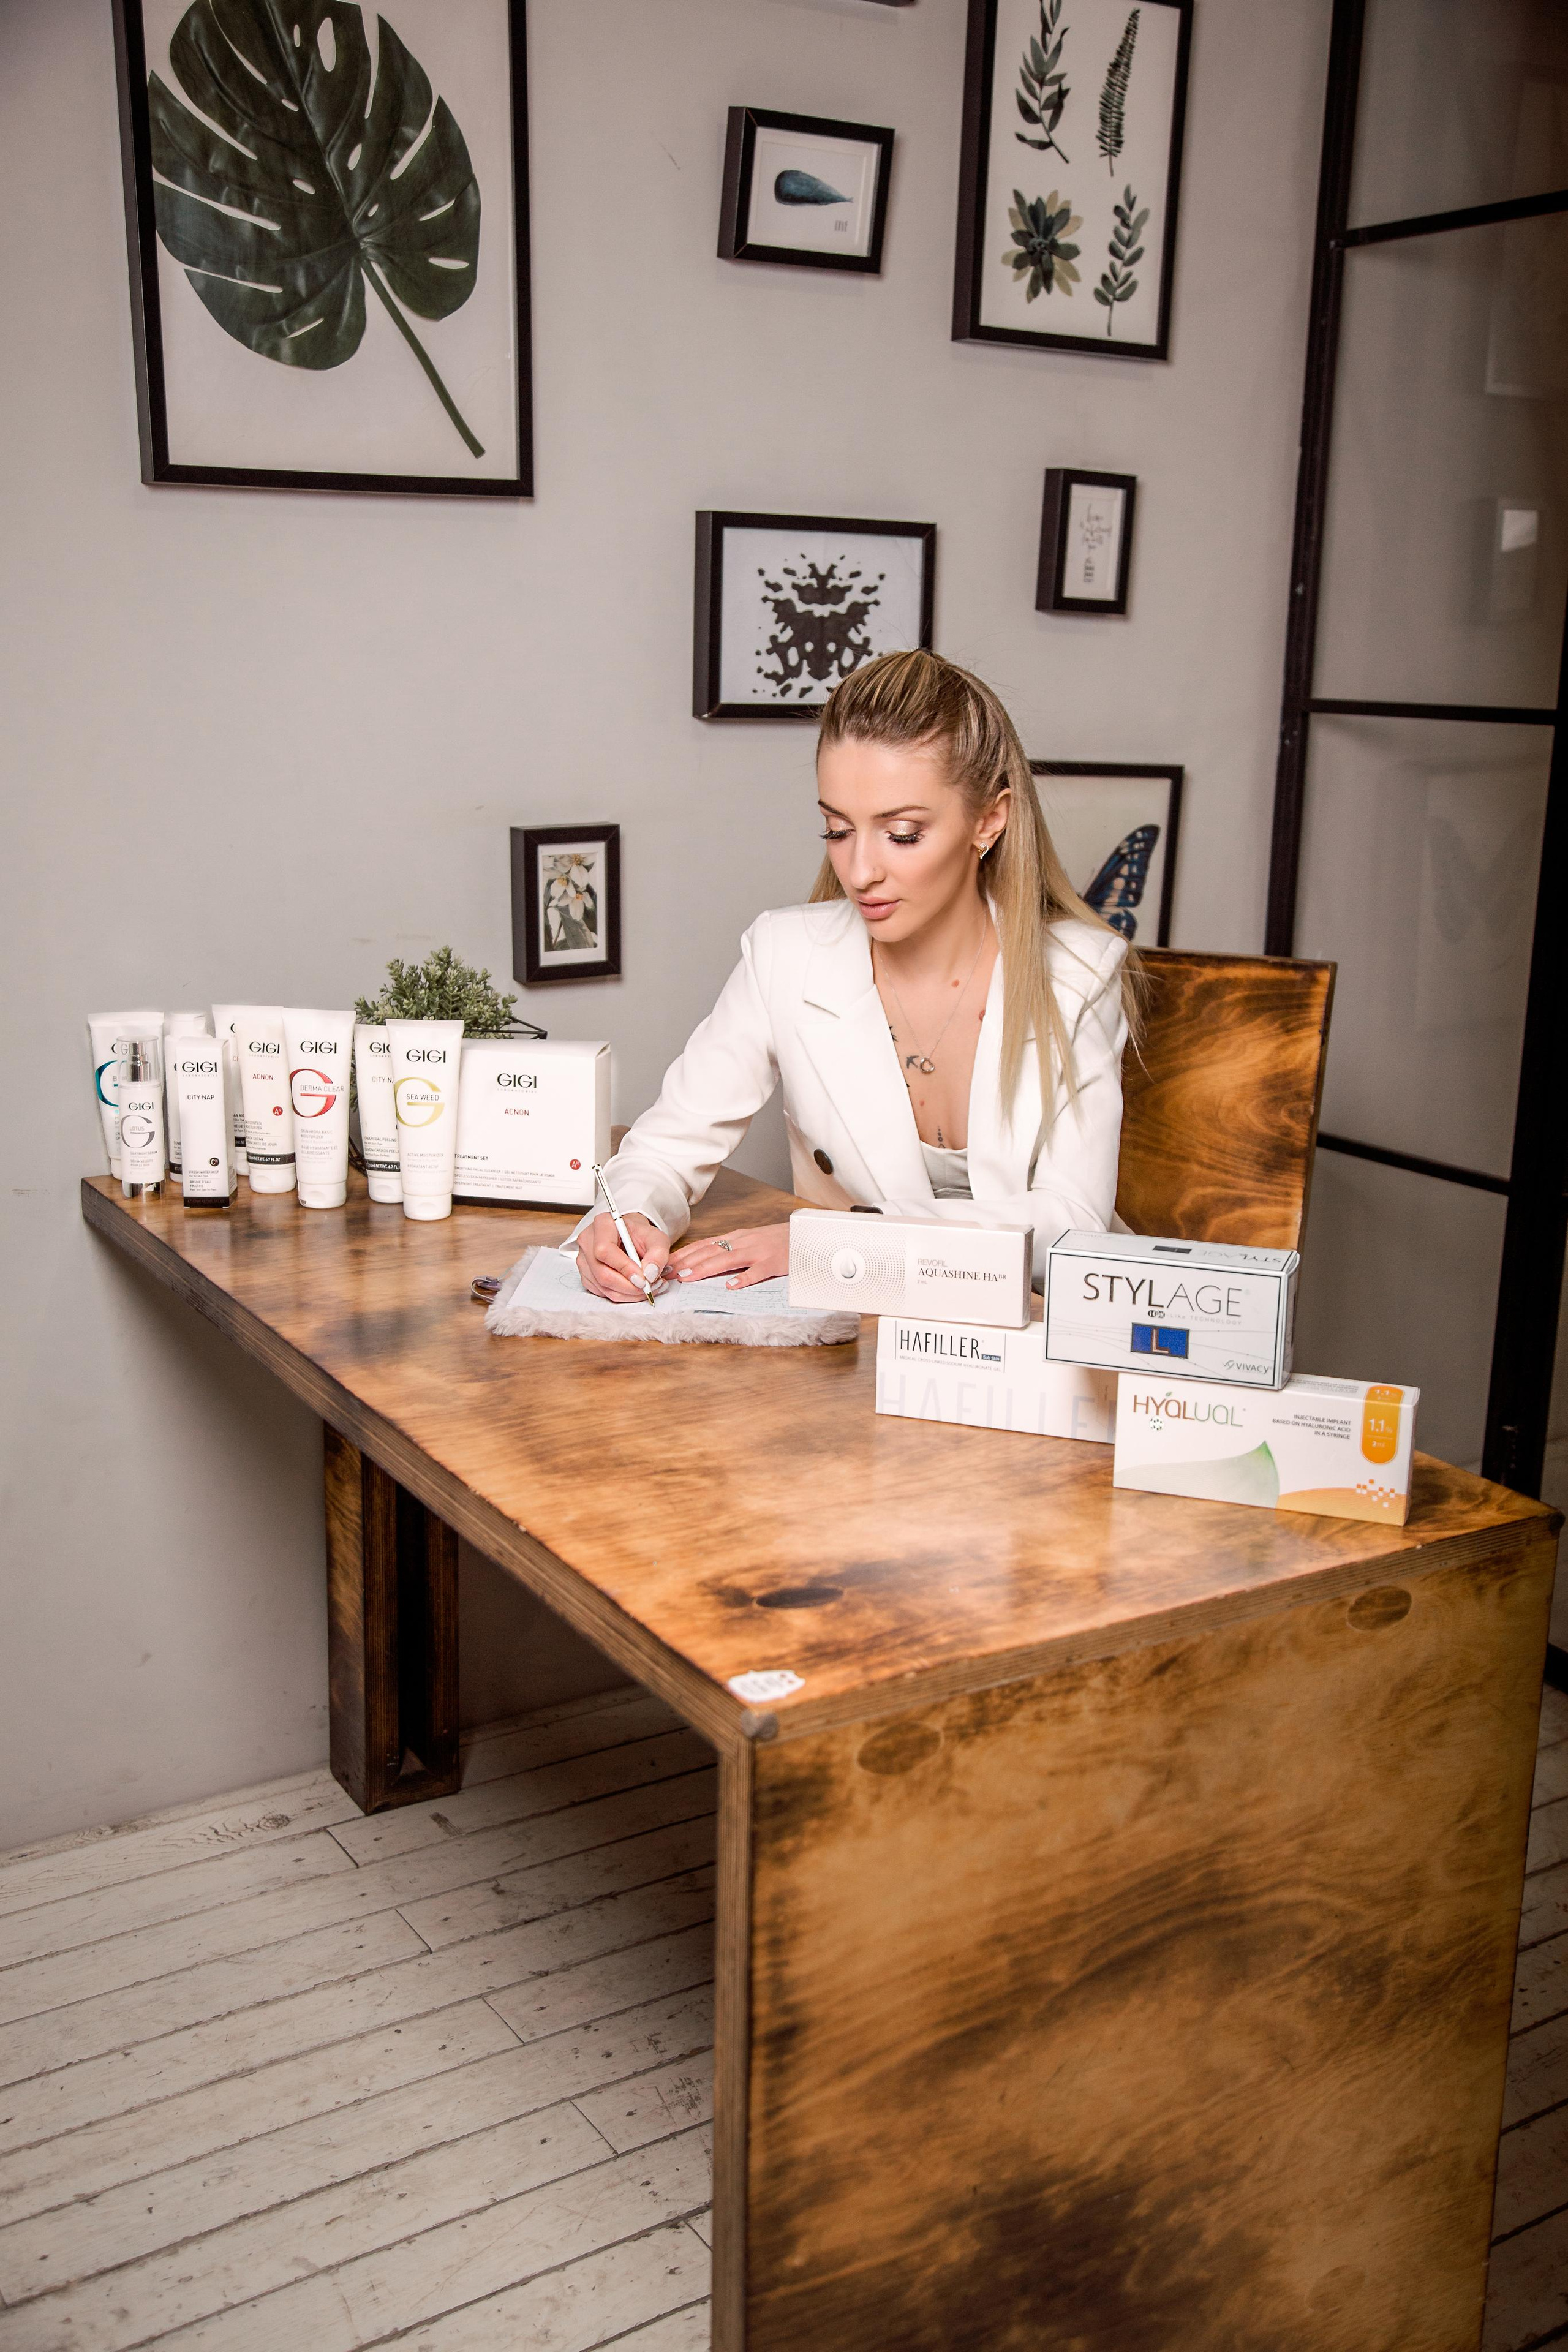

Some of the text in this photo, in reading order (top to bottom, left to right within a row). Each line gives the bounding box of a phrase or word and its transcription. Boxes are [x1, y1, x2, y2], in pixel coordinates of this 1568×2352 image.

[249, 1041, 280, 1054] GIGI
[300, 1041, 337, 1054] GIGI
[406, 1049, 446, 1063] GIGI
[182, 1061, 217, 1072] GIGI
[497, 1073, 537, 1088] GIGI
[129, 1102, 154, 1111] GIGI
[918, 1258, 948, 1267] REVOFIL
[918, 1268, 981, 1281] AQUASHINE
[1083, 1273, 1242, 1317] STYLAGE
[1191, 1316, 1242, 1325] TECHNOLOGY
[900, 1330, 979, 1359] HAFILLER
[1235, 1362, 1269, 1374] VIVACY
[1301, 1422, 1335, 1431] HYALURONIC
